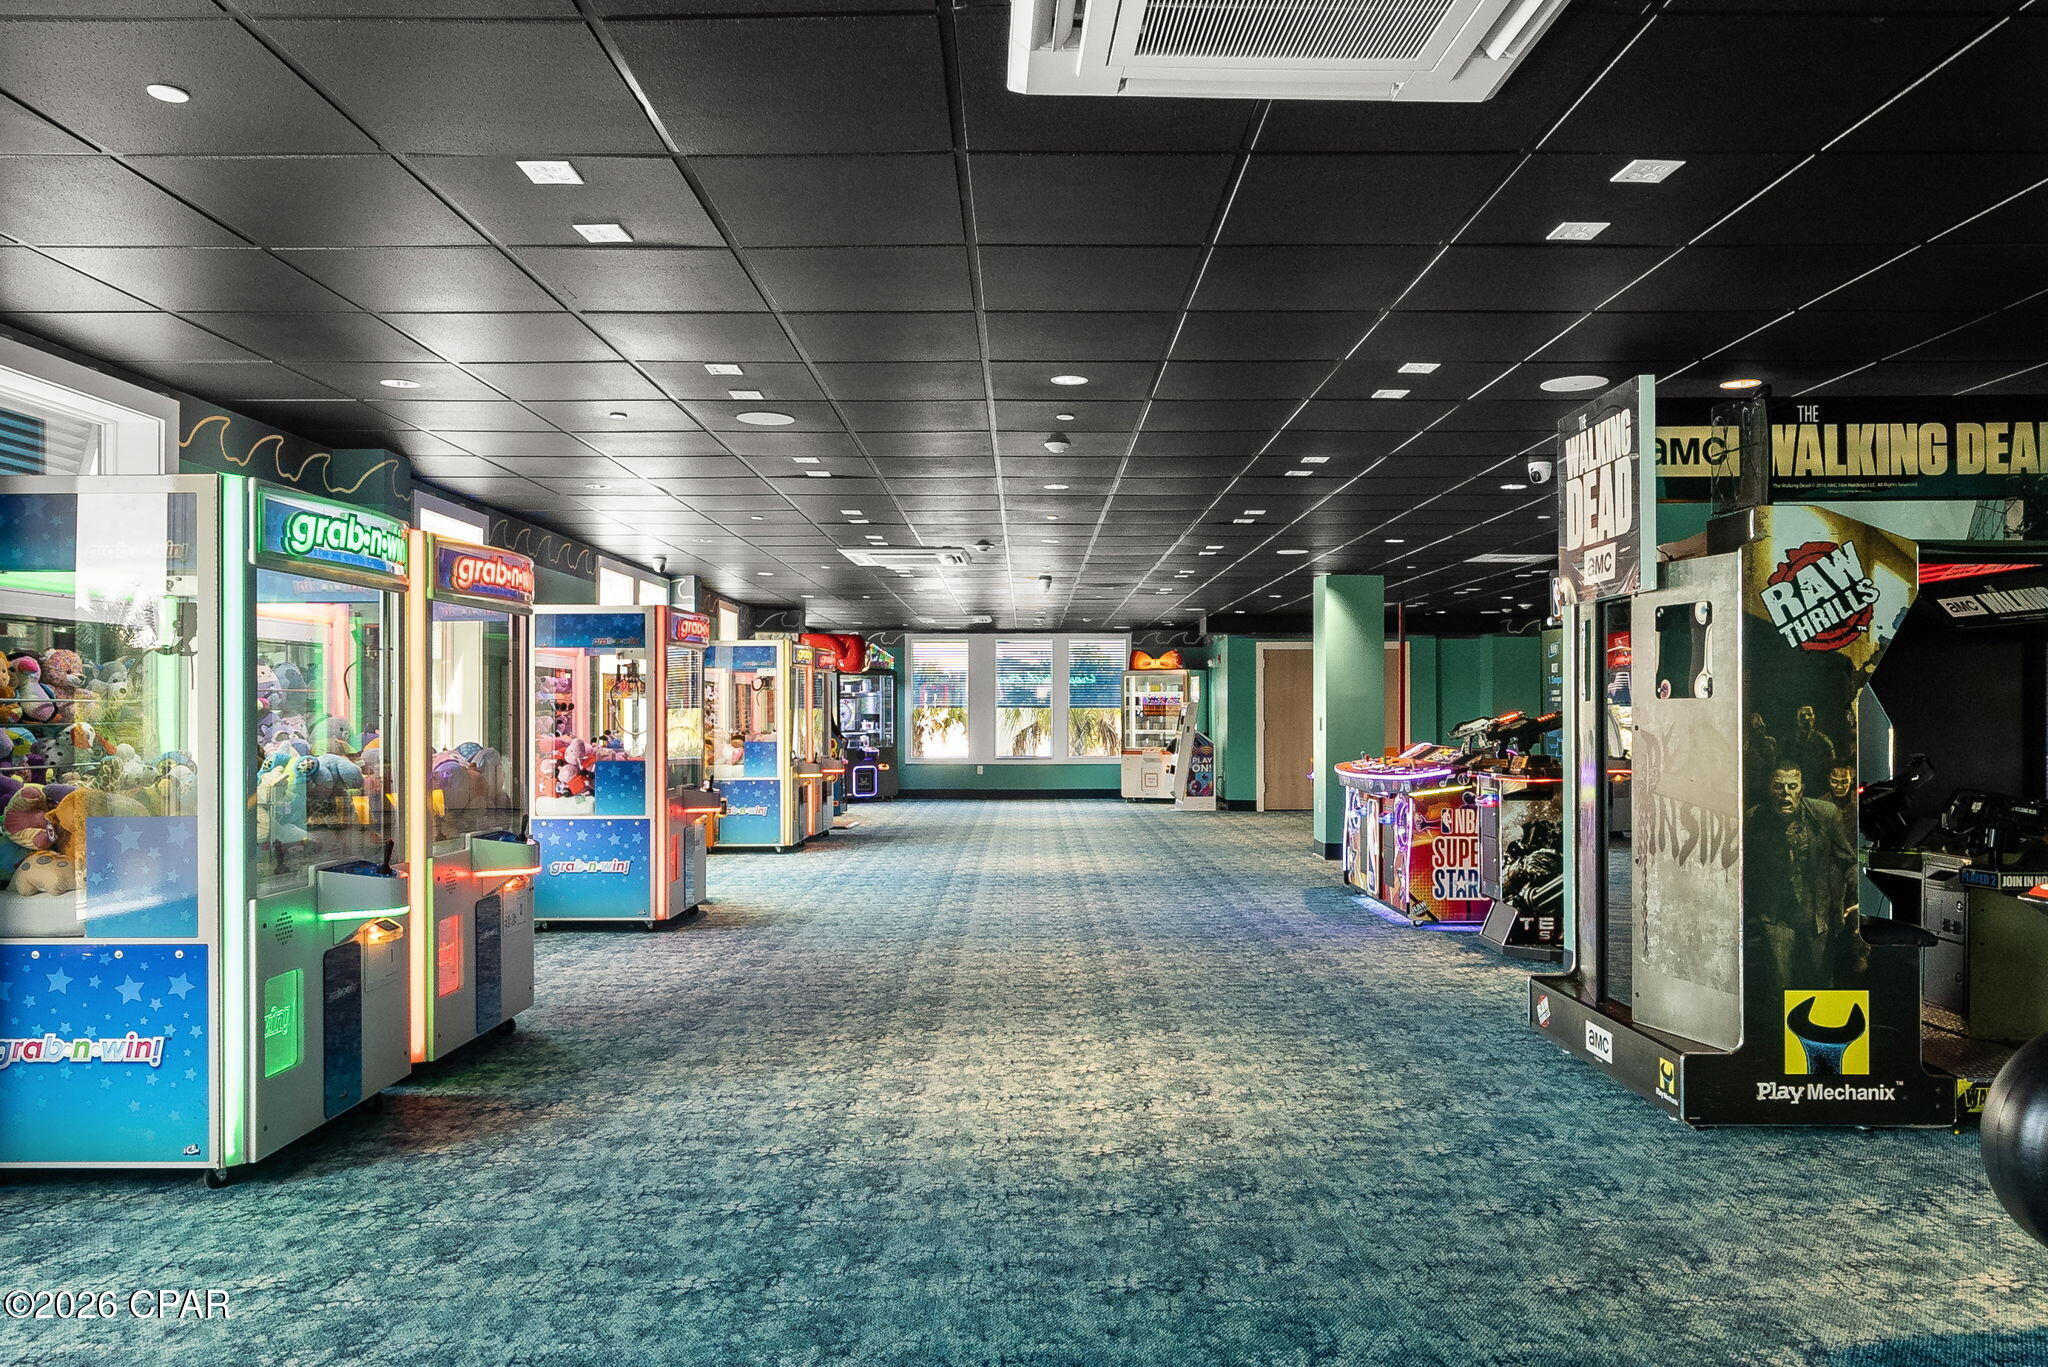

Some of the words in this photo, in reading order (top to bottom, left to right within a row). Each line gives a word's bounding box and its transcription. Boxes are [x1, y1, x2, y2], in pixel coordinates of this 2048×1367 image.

[1797, 405, 1819, 423] THE
[1565, 408, 1632, 481] WALKING
[1566, 455, 1633, 552] DEAD
[1760, 541, 1865, 627] RAW
[1778, 578, 1880, 648] THRILLS
[1191, 756, 1213, 764] PLAY
[1192, 764, 1213, 773] ON!
[1453, 808, 1479, 834] NB
[1433, 838, 1479, 868] SUPE
[1434, 869, 1479, 899] STAR
[2002, 875, 2023, 887] JOIN
[2023, 875, 2034, 887] IN
[1756, 1081, 1804, 1105] Play
[1807, 1083, 1895, 1101] Mechanix
